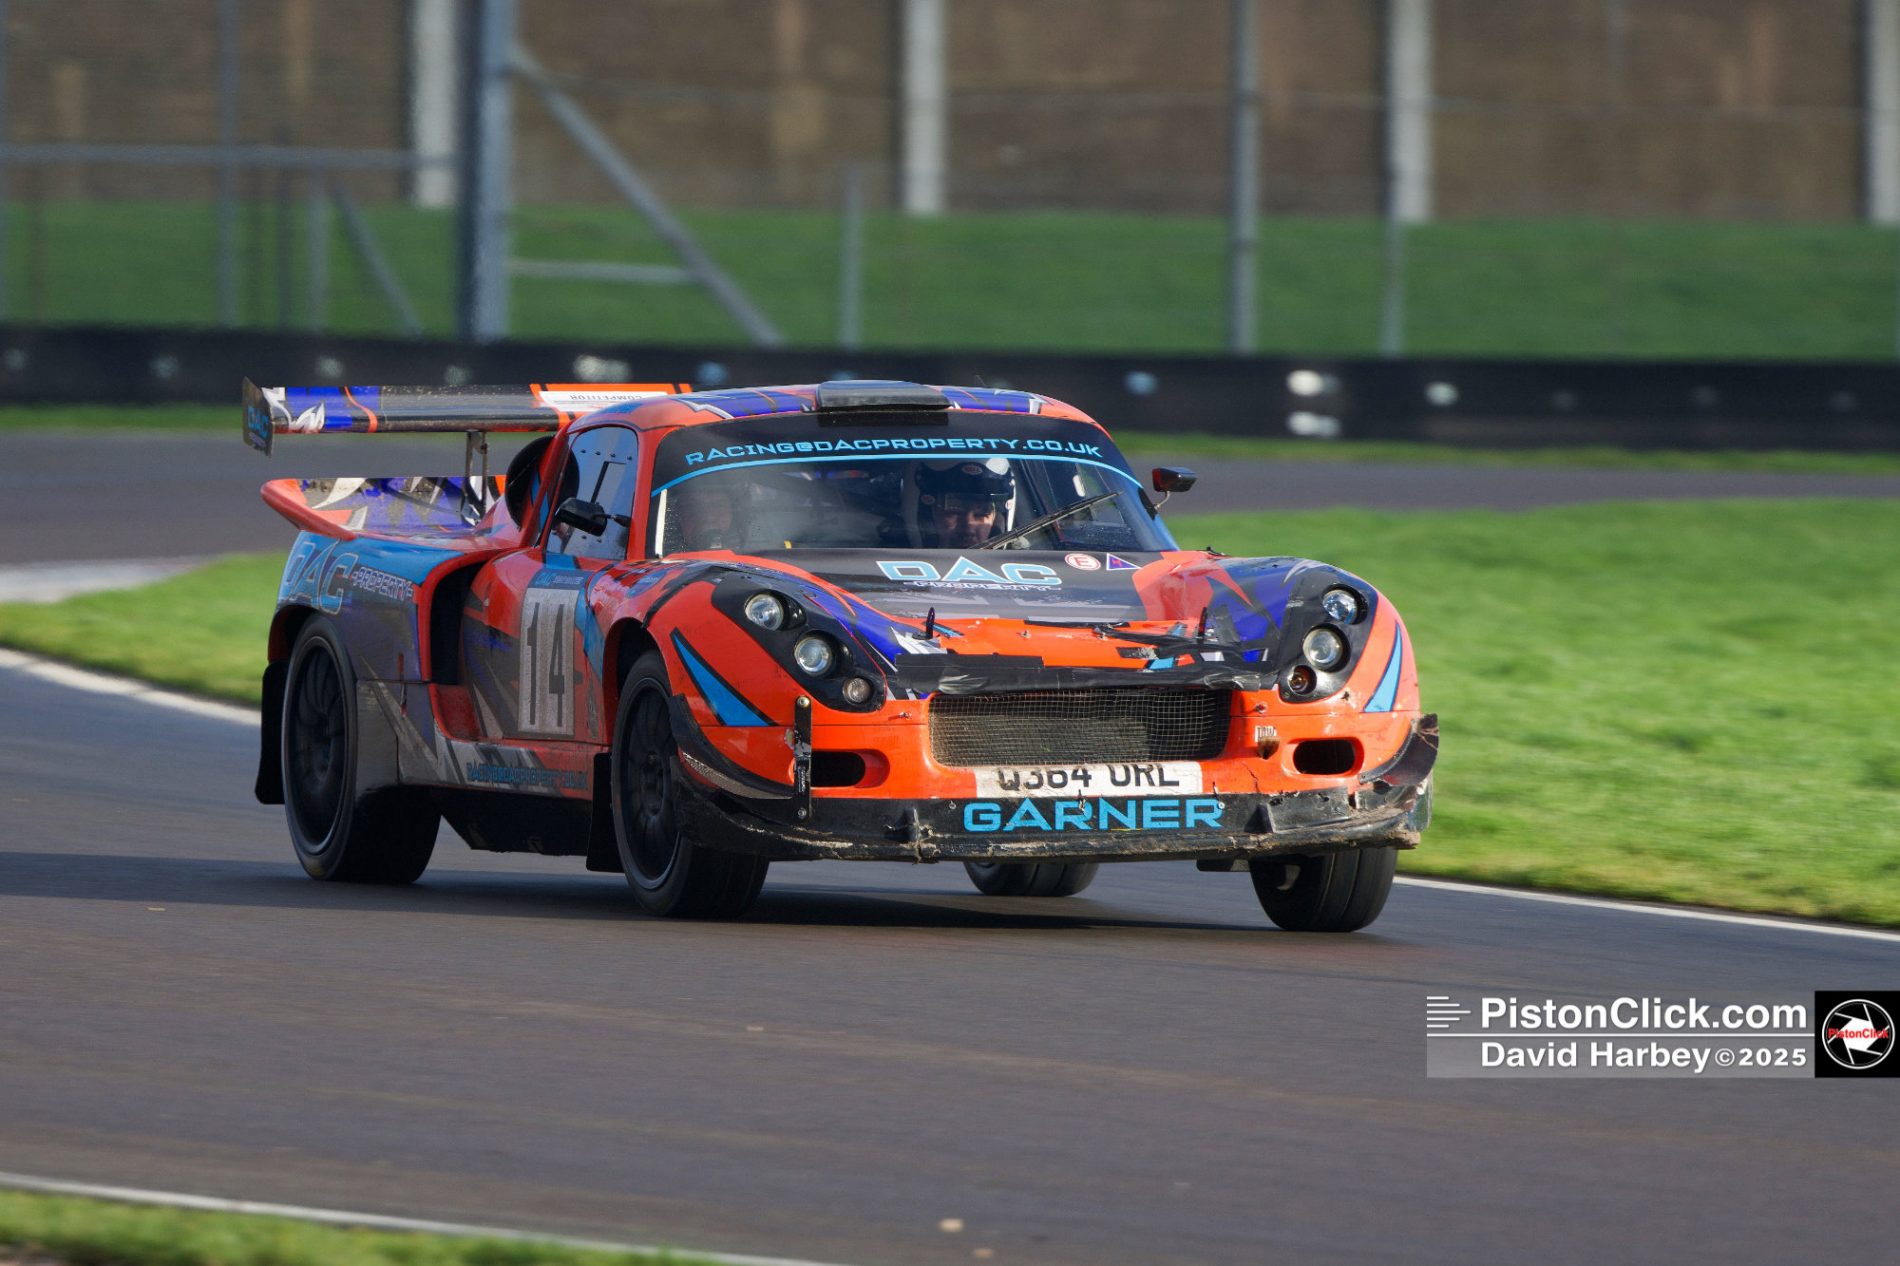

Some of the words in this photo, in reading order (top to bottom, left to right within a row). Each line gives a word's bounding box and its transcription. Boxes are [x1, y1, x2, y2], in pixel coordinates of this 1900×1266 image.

[684, 438, 1103, 466] RACING@DACPROPERTY.CO.UK
[876, 556, 1062, 585] DAC
[527, 602, 565, 728] 14
[998, 766, 1092, 791] Q364
[964, 797, 1224, 832] GARNER
